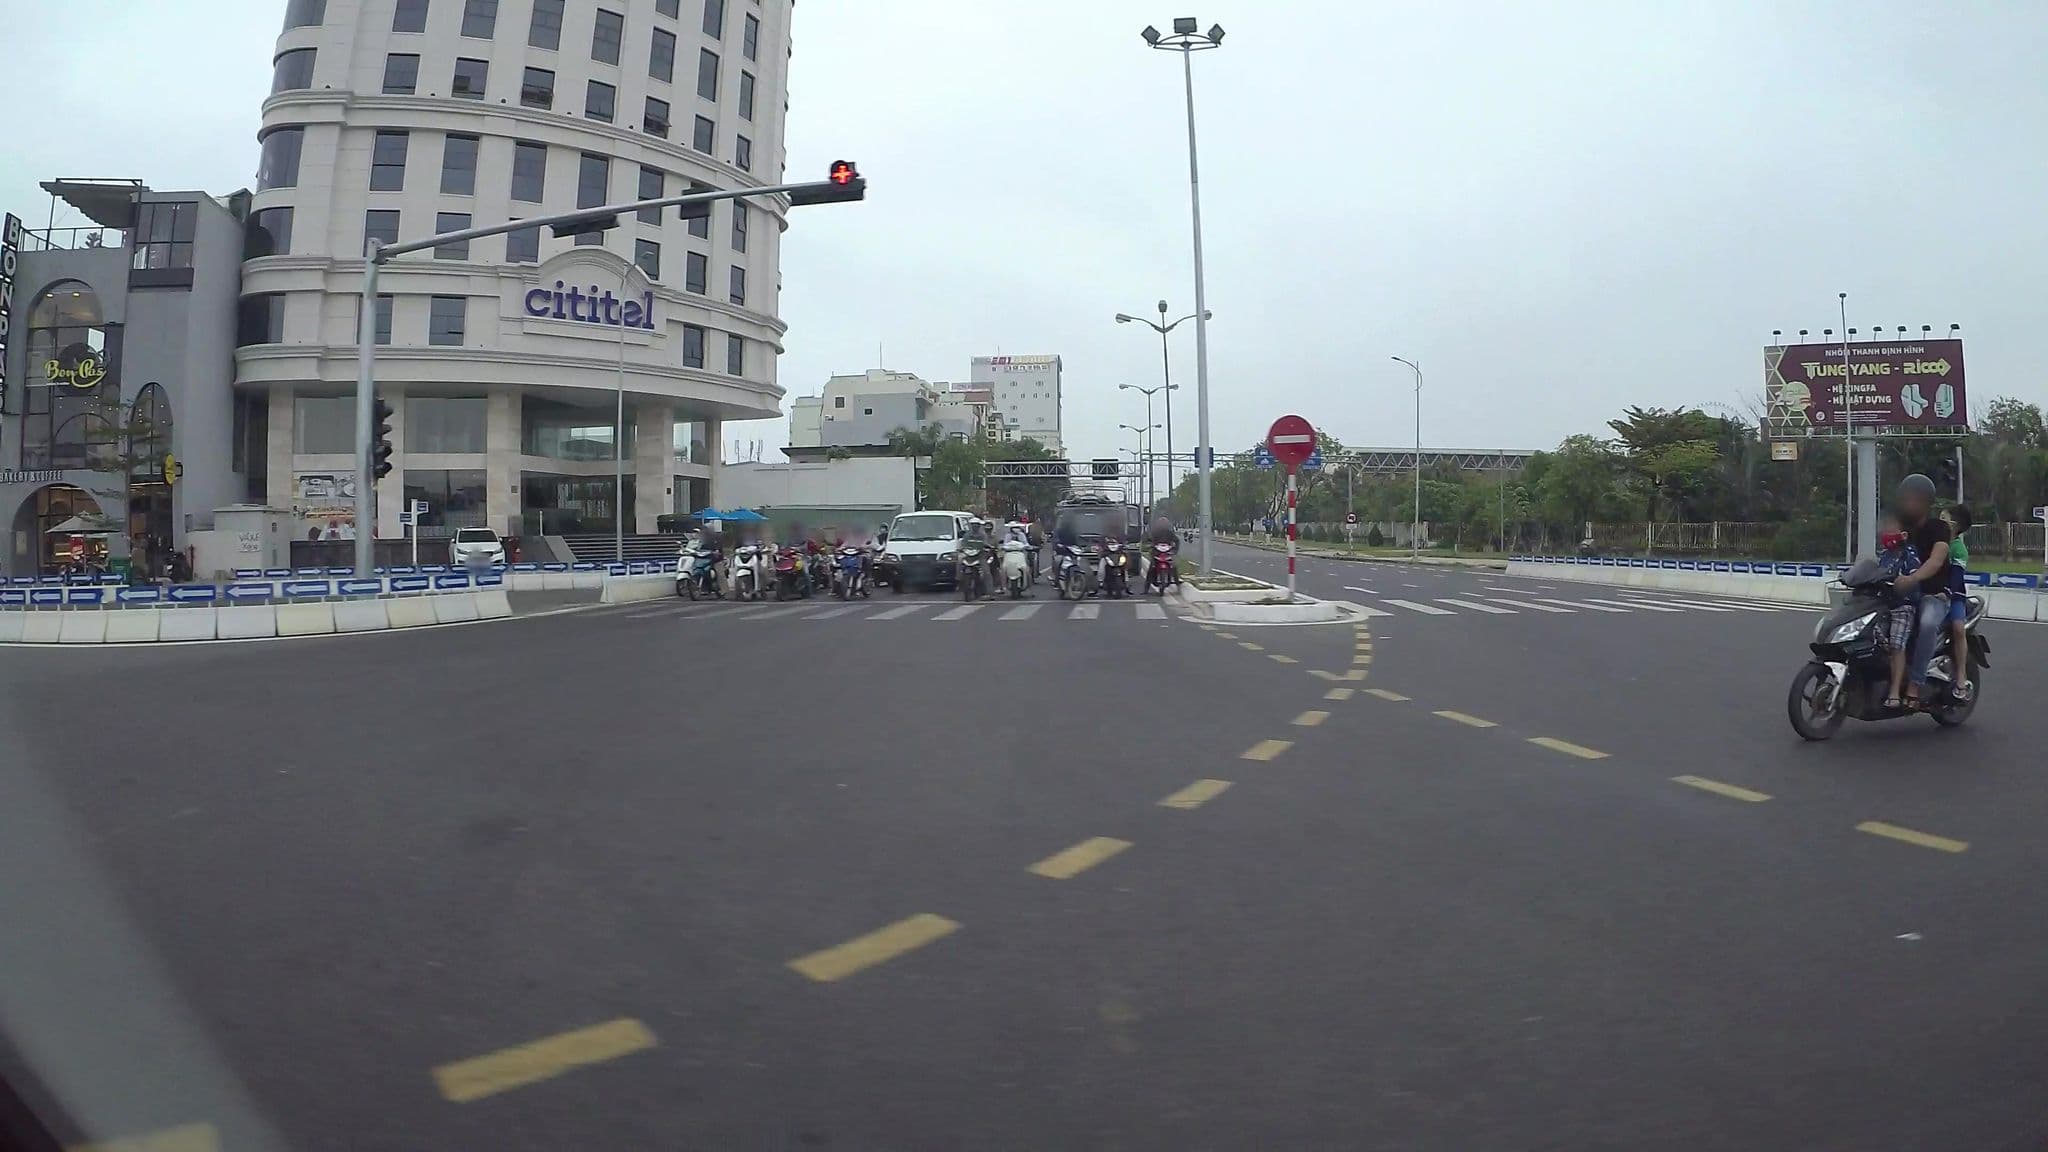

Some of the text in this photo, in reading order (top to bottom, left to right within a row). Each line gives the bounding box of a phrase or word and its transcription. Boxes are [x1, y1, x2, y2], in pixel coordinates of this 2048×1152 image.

[525, 280, 655, 329] cititel
[1881, 347, 1902, 356] ĐỊNH
[1903, 345, 1925, 354] HÌNH
[1801, 362, 1847, 379] TUNG
[1849, 363, 1891, 375] YANG
